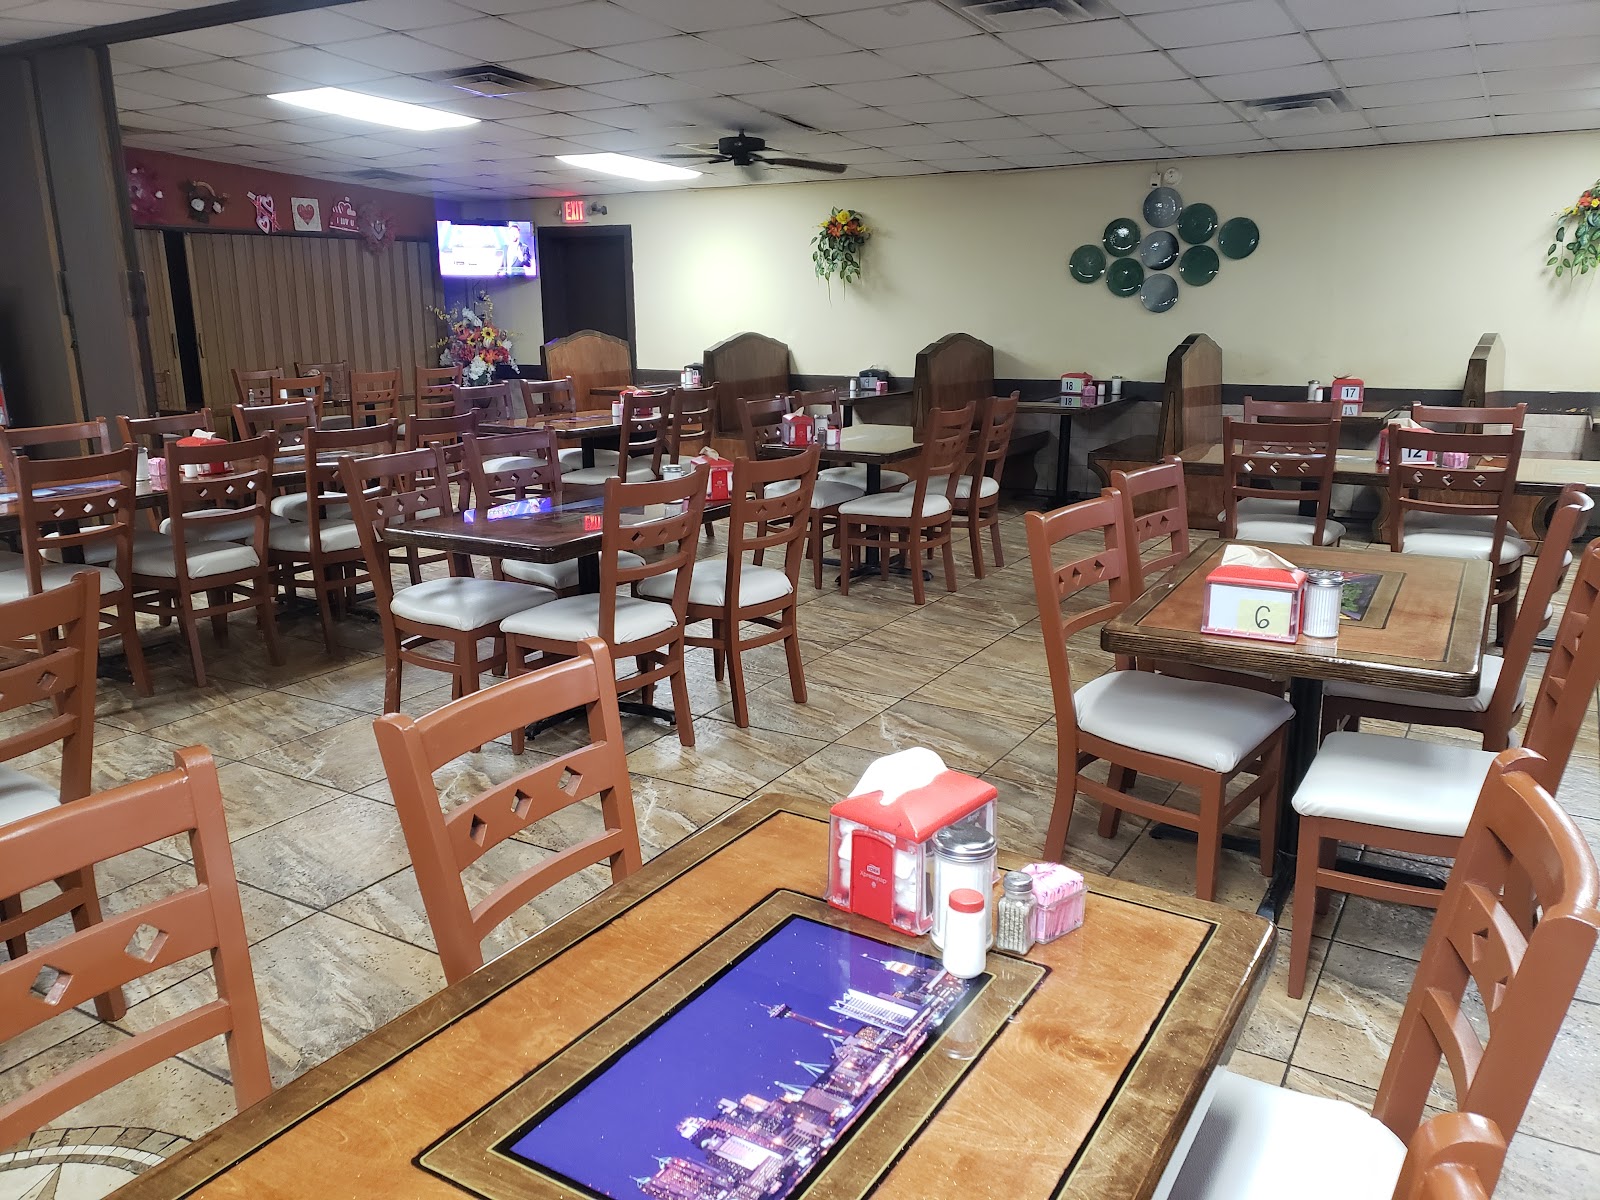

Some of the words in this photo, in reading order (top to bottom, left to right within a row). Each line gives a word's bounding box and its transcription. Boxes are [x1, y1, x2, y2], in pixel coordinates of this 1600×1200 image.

[565, 200, 584, 220] EXIT
[1065, 381, 1074, 391] 18
[1345, 387, 1356, 398] 17
[1407, 448, 1422, 458] 12
[1255, 605, 1271, 629] 6
